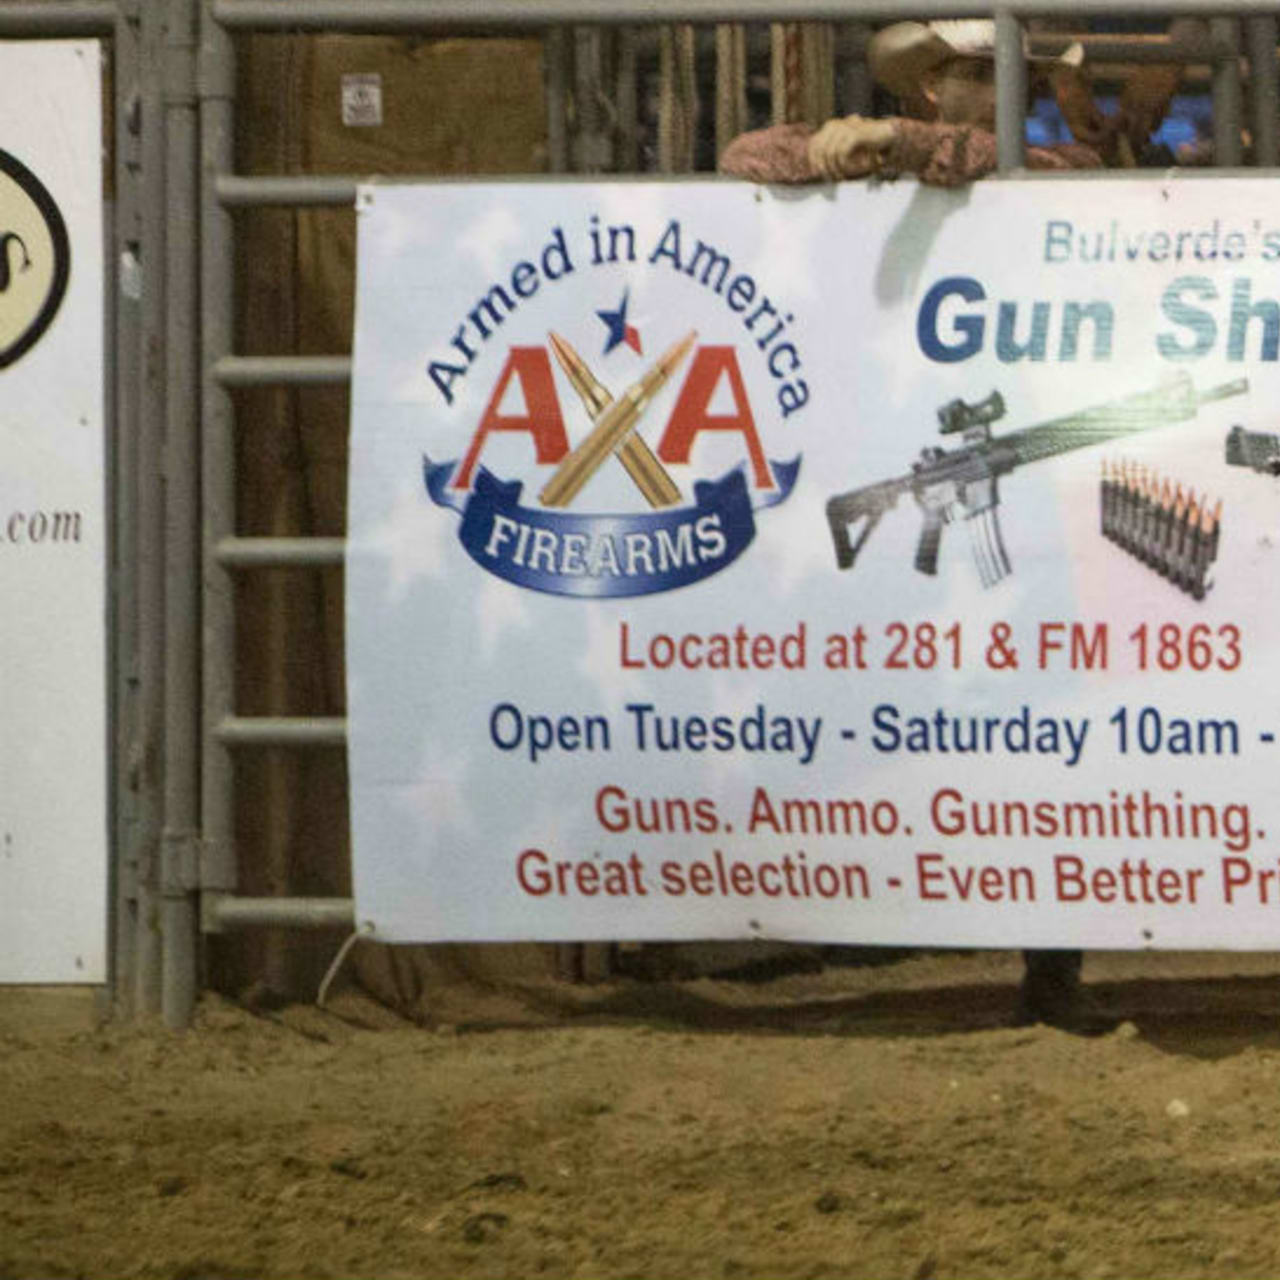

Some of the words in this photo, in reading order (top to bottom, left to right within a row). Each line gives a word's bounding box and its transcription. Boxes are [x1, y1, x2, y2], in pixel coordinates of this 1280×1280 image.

[425, 228, 576, 406] Armed
[589, 215, 637, 264] in
[648, 219, 811, 419] America
[916, 276, 1115, 364] Gun
[484, 514, 727, 577] FIREARMS
[619, 622, 806, 670] Located
[823, 625, 868, 670] at
[884, 622, 961, 670] 281
[984, 621, 1019, 671] &
[1037, 622, 1109, 671] FM
[1129, 622, 1242, 672] 1863
[489, 703, 611, 762] Open
[625, 703, 822, 764] Tuesday
[872, 703, 1090, 767] Saturday
[1109, 706, 1240, 755] 10am
[594, 784, 733, 833] Guns.
[748, 786, 913, 836] Ammo.
[930, 787, 1266, 852] Gunsmithing.
[515, 848, 649, 897] Great
[660, 850, 871, 900] selection
[916, 853, 1036, 902] Even
[1053, 854, 1204, 904] Better
